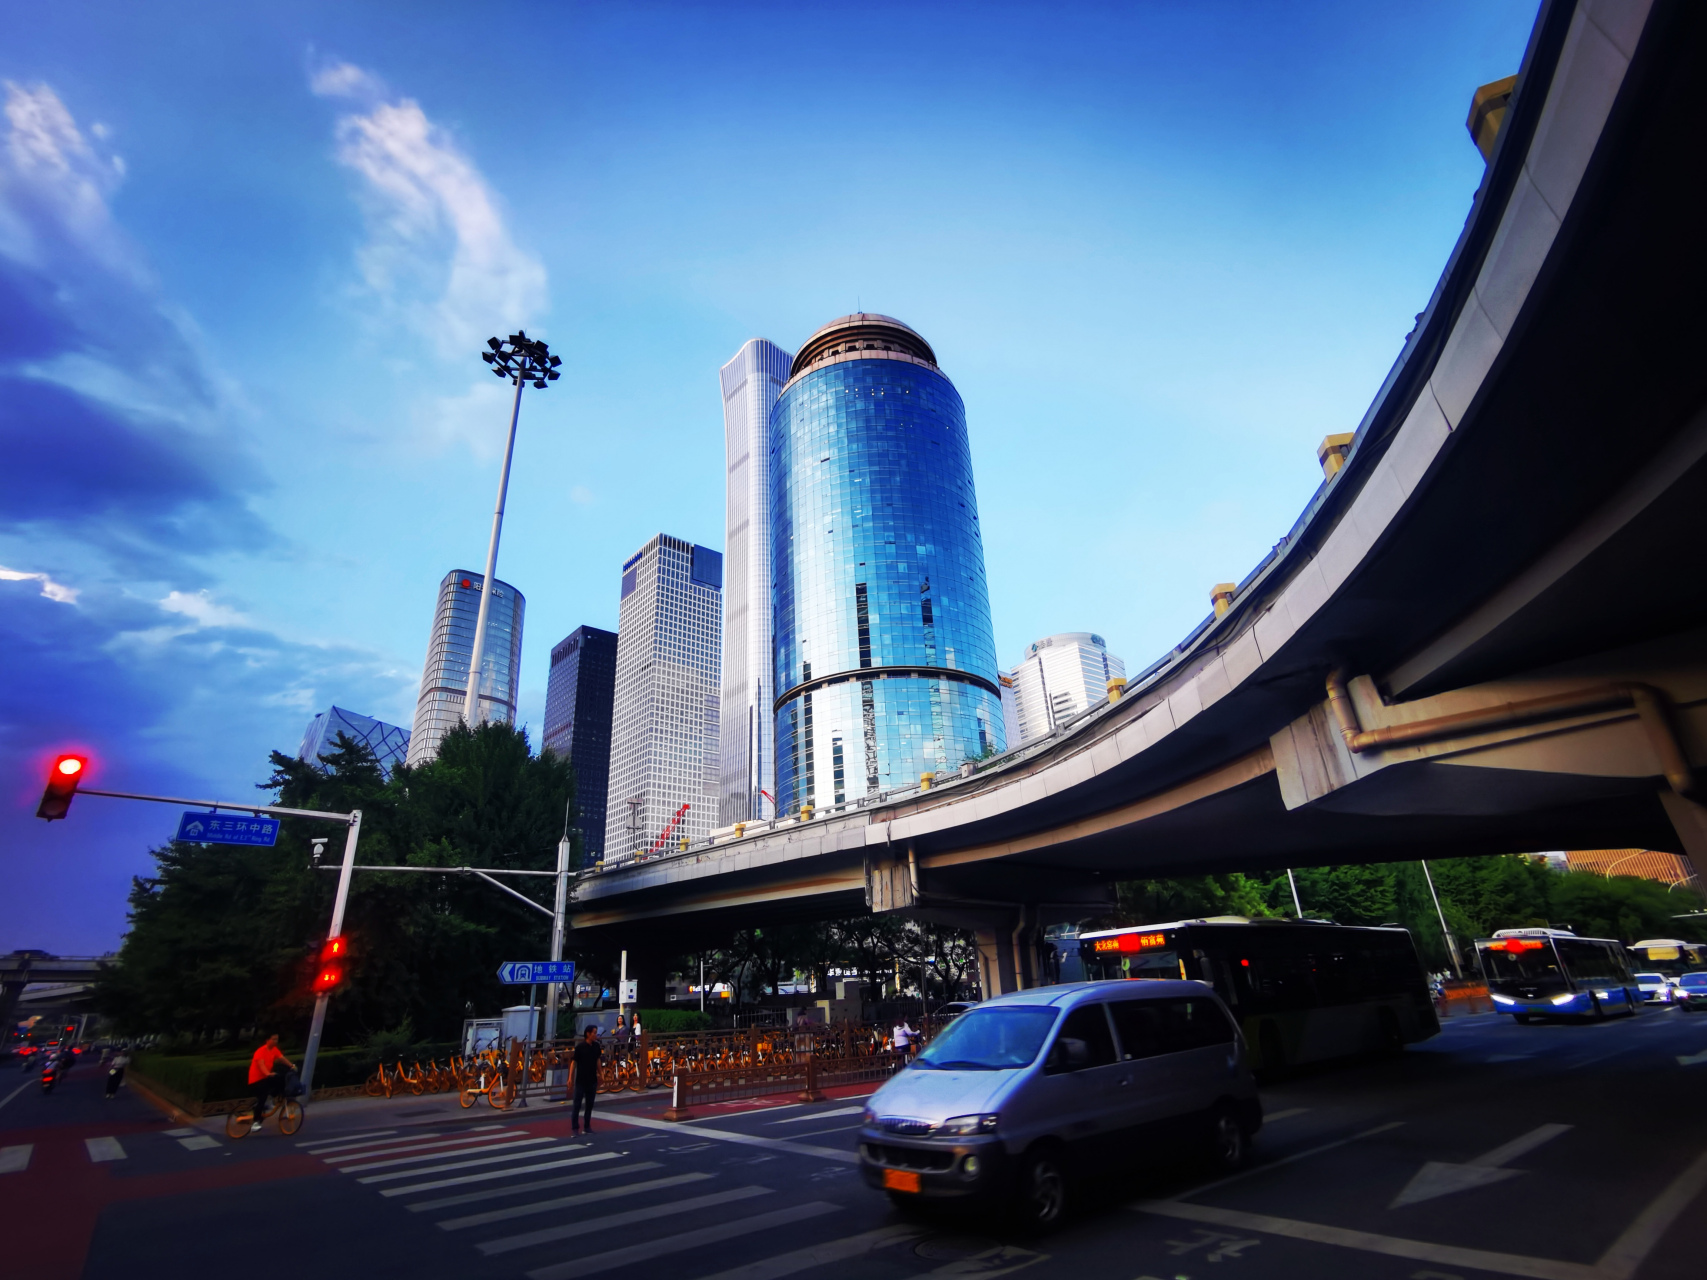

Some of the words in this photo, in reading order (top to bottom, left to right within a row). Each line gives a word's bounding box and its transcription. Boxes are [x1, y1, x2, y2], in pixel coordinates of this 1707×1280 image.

[208, 820, 273, 835] 东三环中路
[533, 964, 572, 974] 地铁站
